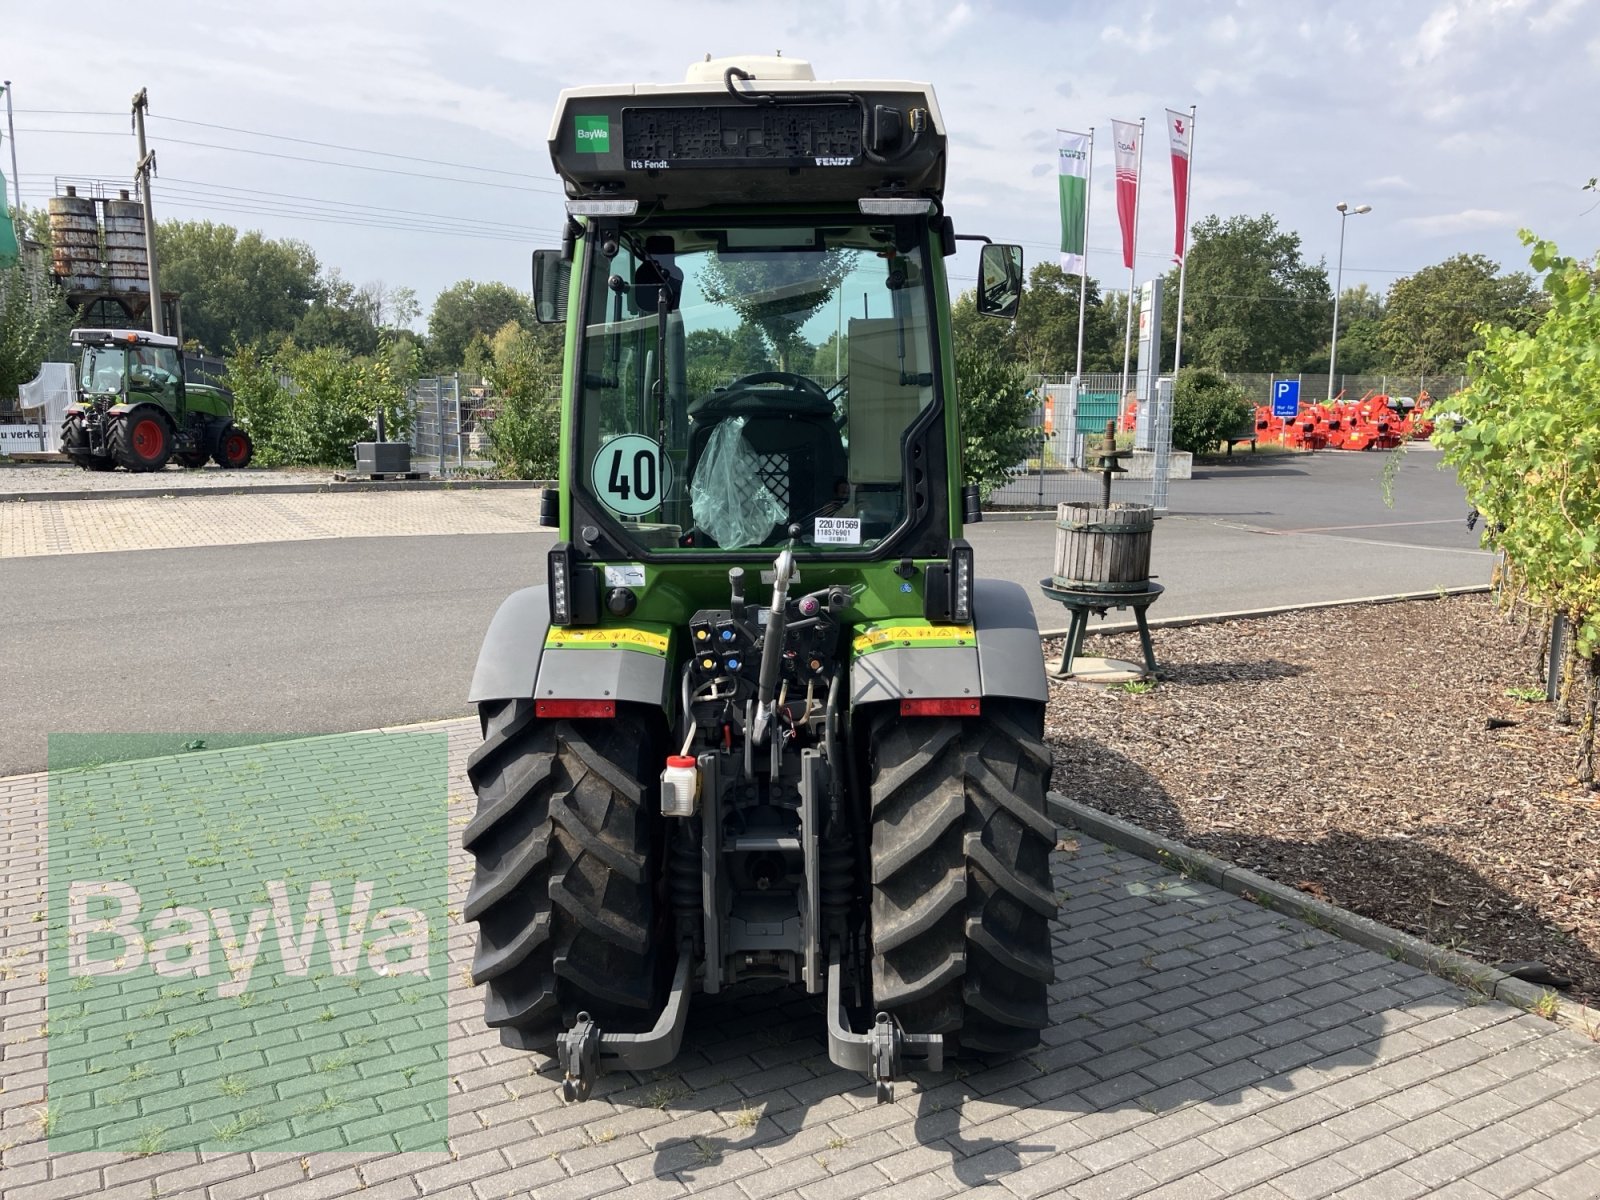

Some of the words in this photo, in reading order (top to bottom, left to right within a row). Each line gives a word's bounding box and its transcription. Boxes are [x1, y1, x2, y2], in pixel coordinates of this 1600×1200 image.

[577, 129, 608, 140] BayWa
[631, 161, 643, 169] It's
[645, 160, 670, 169] Fendt.
[815, 157, 854, 166] FENDT
[1278, 383, 1289, 398] P
[0, 431, 7, 439] u
[608, 449, 656, 501] 40
